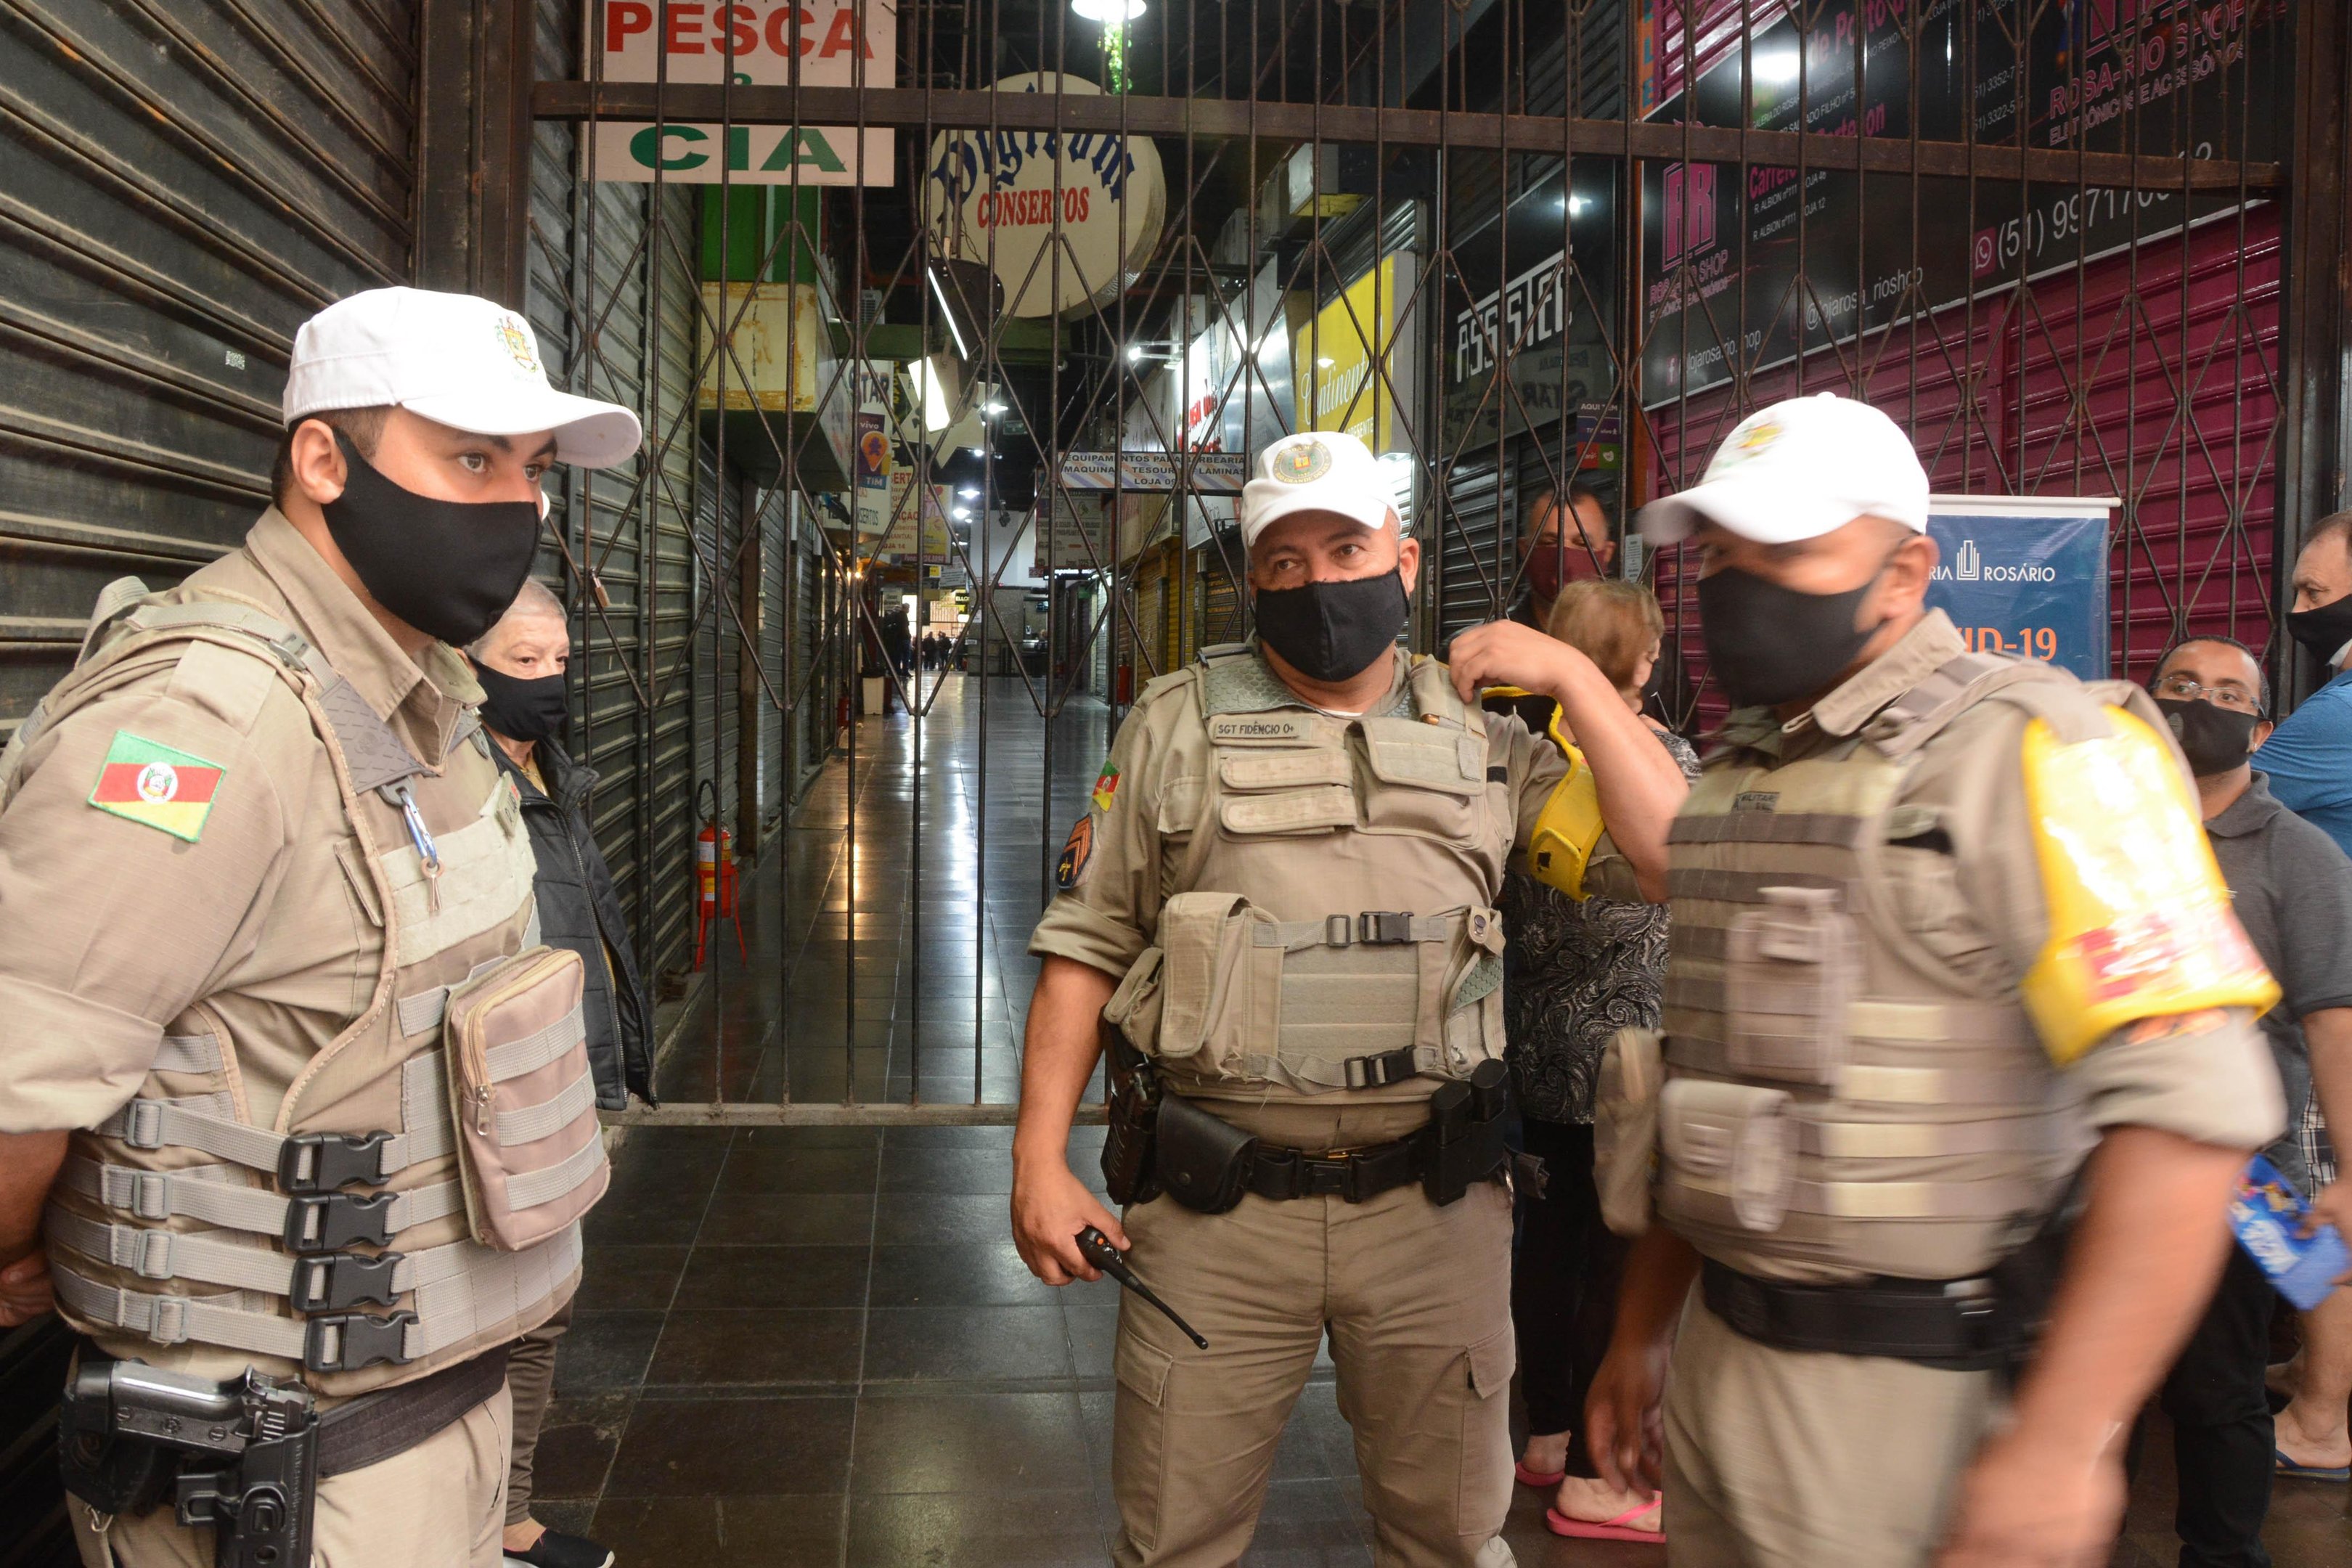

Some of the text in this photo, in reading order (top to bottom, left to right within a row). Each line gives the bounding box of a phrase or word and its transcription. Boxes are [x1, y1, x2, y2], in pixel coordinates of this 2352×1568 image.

[607, 1, 875, 60] PESCA
[2050, 36, 2165, 119] ROSA-RIO
[629, 125, 847, 172] CIA
[977, 186, 1090, 229] CONSEROS
[1998, 209, 2044, 269] (51)
[1699, 249, 1728, 282] SHOP
[1456, 247, 1572, 383] ASSSTEC
[1806, 266, 1923, 330] @ojaros_rioshop
[1301, 348, 1373, 425] Cntinenta
[859, 421, 879, 430] vivo
[1064, 465, 1116, 475] MAQUINA
[1132, 466, 1176, 475] TESOUR
[1066, 454, 1246, 465] EQUIPAMNTOS PARA BRBEARIA
[866, 477, 883, 486] TIM
[1984, 563, 2055, 581] ROSÁRIO
[1958, 628, 2057, 661] ID-19
[1218, 724, 1236, 735] SGT
[1239, 721, 1281, 735] FIDÊNCIO
